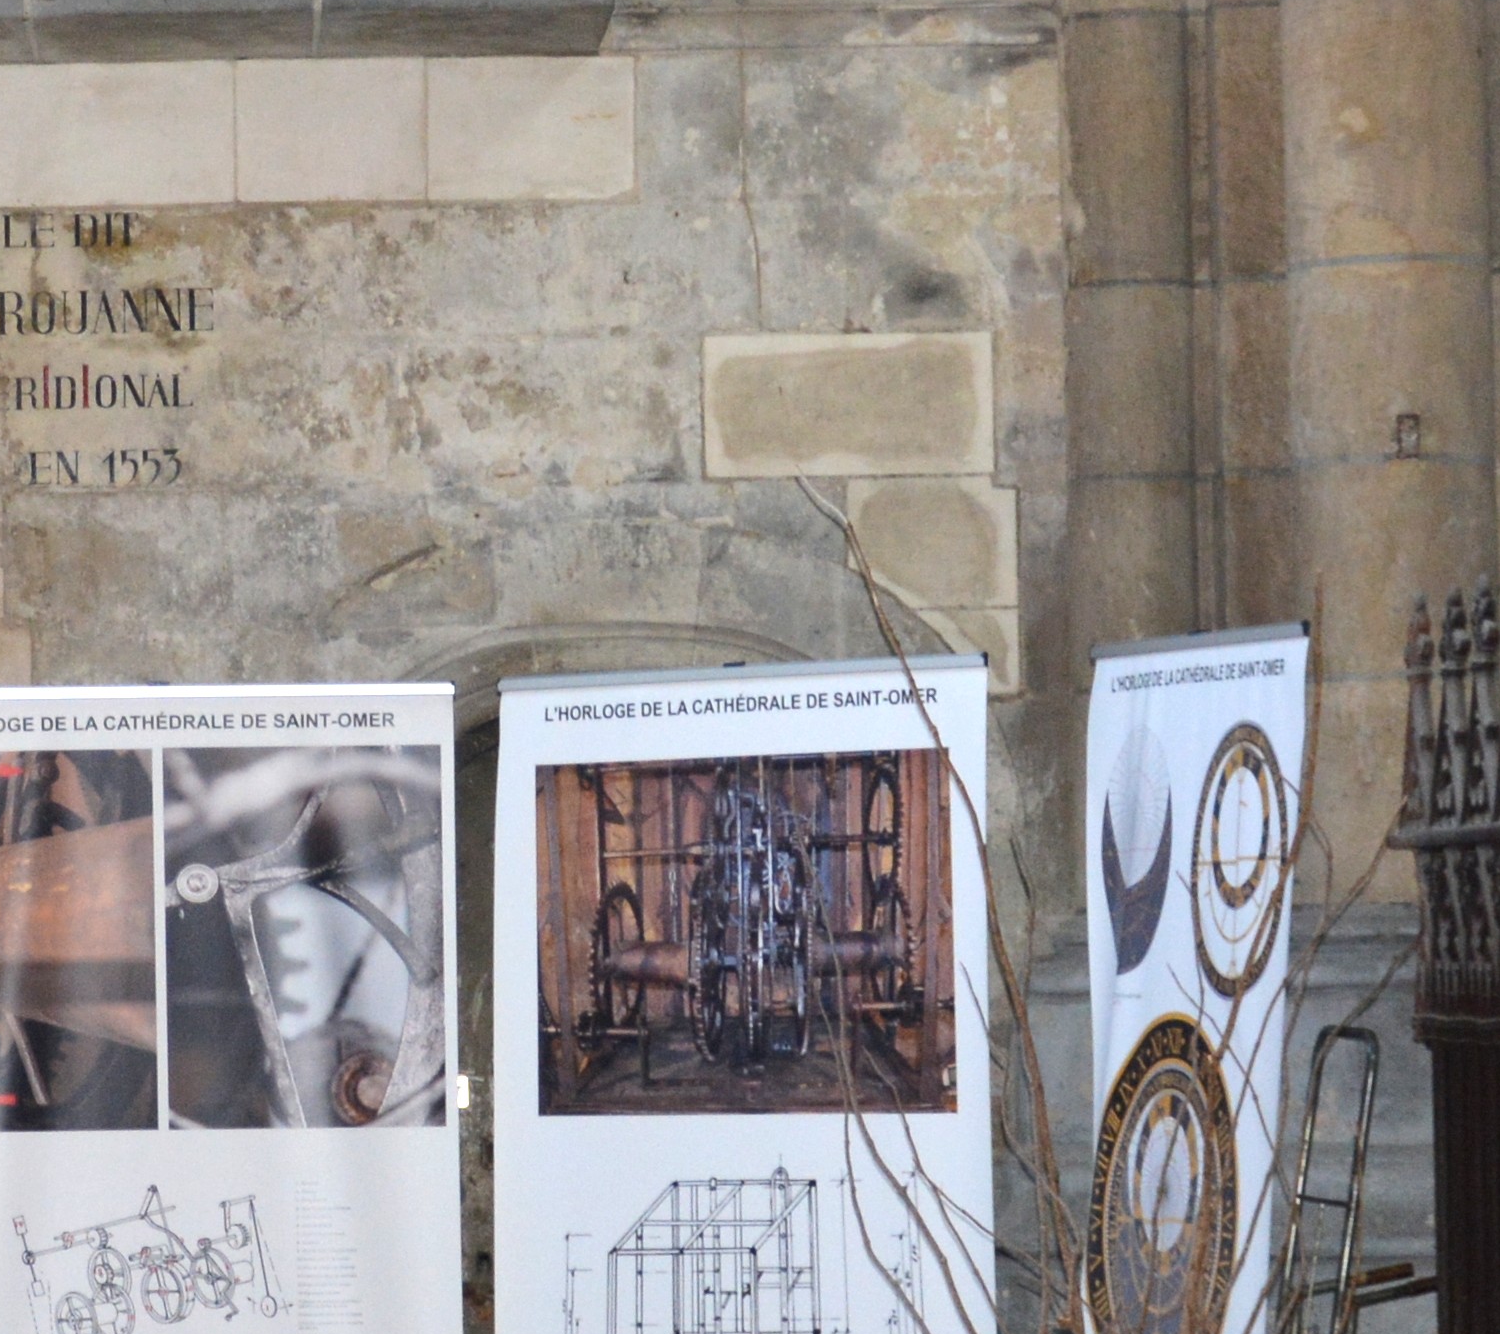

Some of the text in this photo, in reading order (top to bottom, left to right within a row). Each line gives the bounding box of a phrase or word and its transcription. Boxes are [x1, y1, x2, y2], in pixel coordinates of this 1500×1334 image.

[74, 212, 138, 247] DIT
[29, 450, 79, 485] EN
[101, 449, 182, 485] 1553
[40, 715, 67, 732] DE
[73, 715, 98, 731] LA
[103, 711, 234, 731] CATHÉDRALE
[241, 713, 266, 729] DE
[272, 712, 395, 729] SAINT-OMER
[544, 688, 938, 722] L'HORLOGE DE LA CATHÉDRALE DE SAINT-OMER
